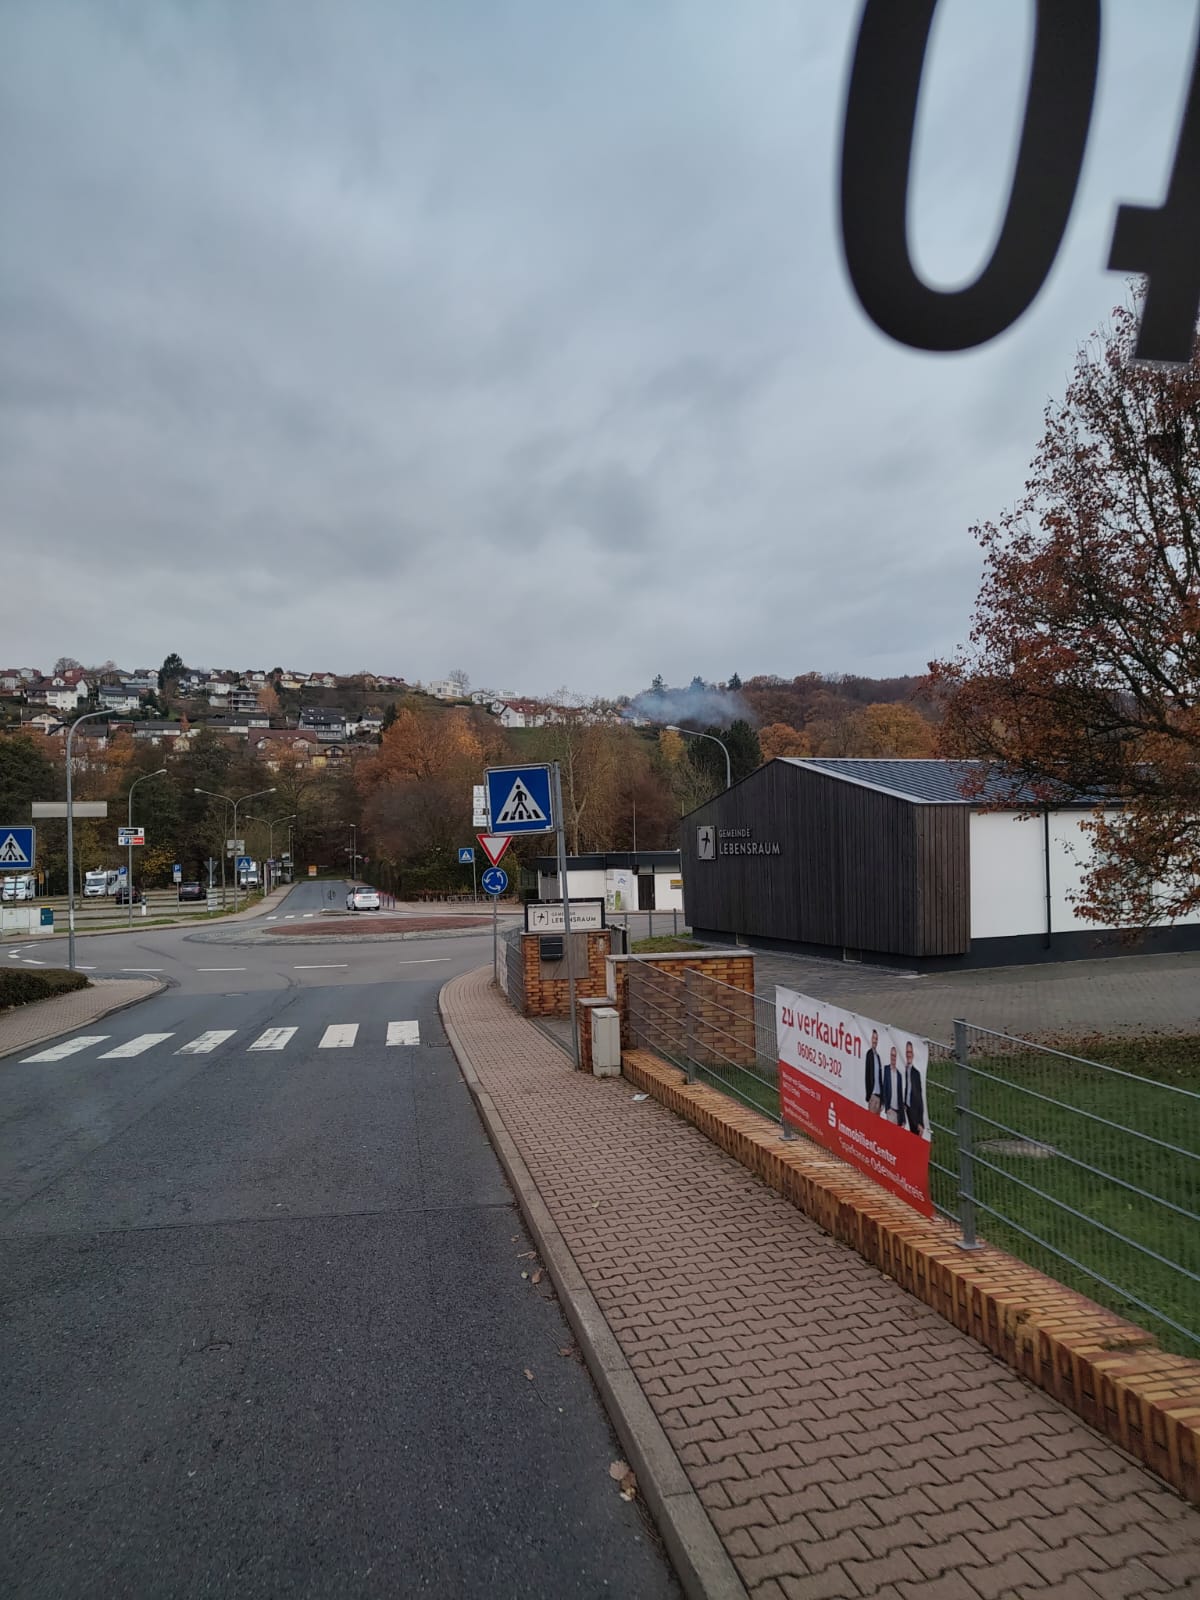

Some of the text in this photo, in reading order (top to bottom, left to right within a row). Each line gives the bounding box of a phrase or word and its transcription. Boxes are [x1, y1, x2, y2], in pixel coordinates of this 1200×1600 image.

[718, 828, 751, 838] GEMEINDE
[719, 842, 780, 855] LEBENSRAUM
[551, 916, 596, 924] LEBNSRAUM
[781, 1006, 862, 1059] zu verkaufen
[797, 1041, 817, 1064] 06062
[818, 1051, 842, 1078] 50-302
